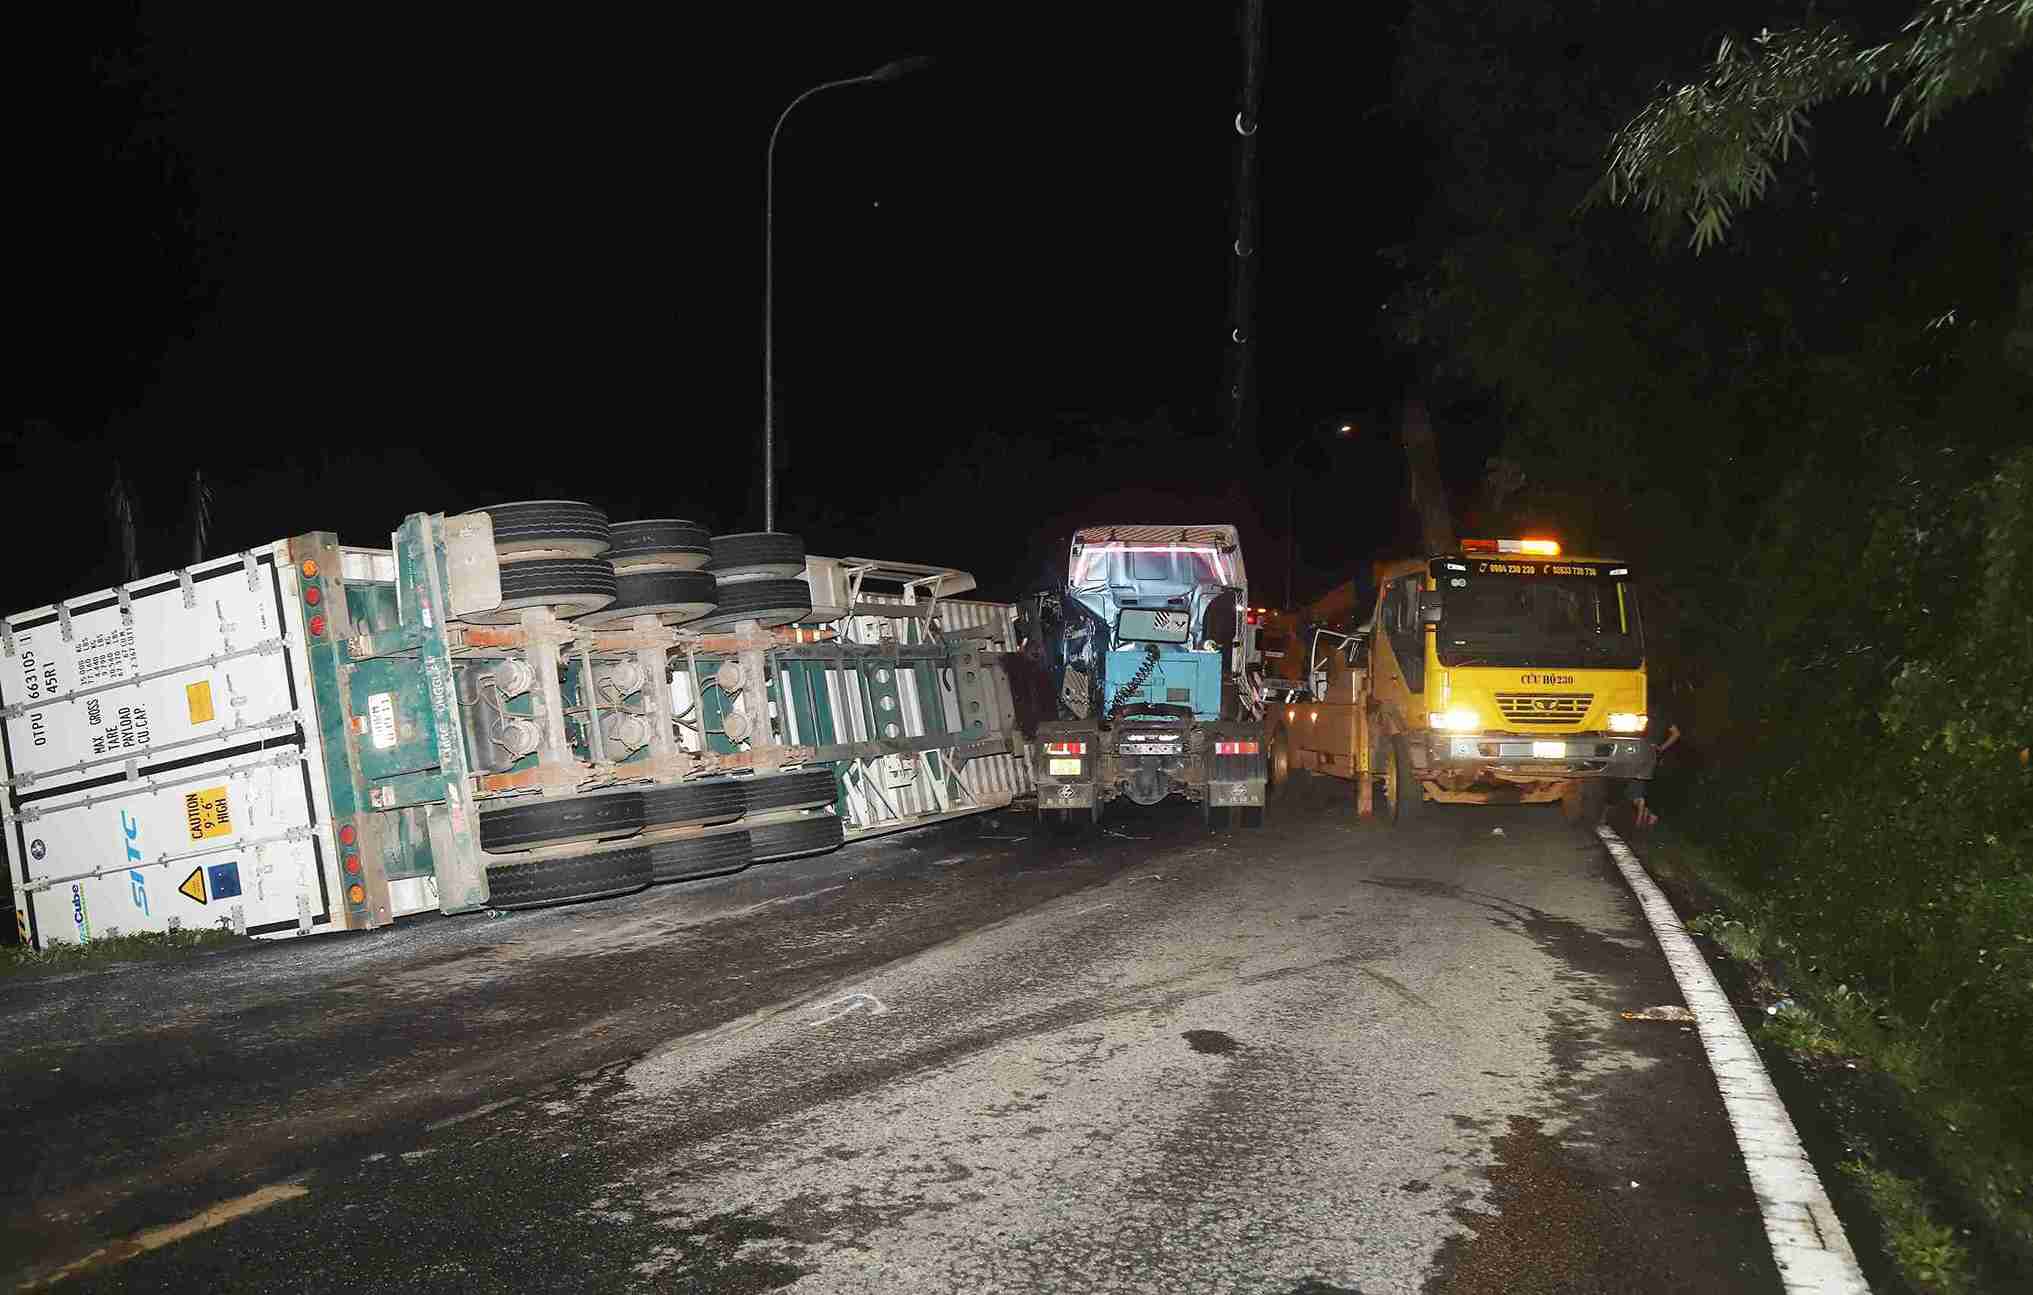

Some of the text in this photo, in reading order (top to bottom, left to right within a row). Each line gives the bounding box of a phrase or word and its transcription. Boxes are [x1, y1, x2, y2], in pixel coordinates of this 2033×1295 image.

[21, 650, 40, 699] 663105
[43, 661, 58, 694] 45R1
[31, 713, 47, 746] OTPU
[87, 698, 106, 755] MAX GROSS
[105, 725, 121, 751] TARE
[118, 706, 135, 748] PAYLOAD
[186, 793, 203, 840] CAUTION
[215, 797, 230, 824] HIGH
